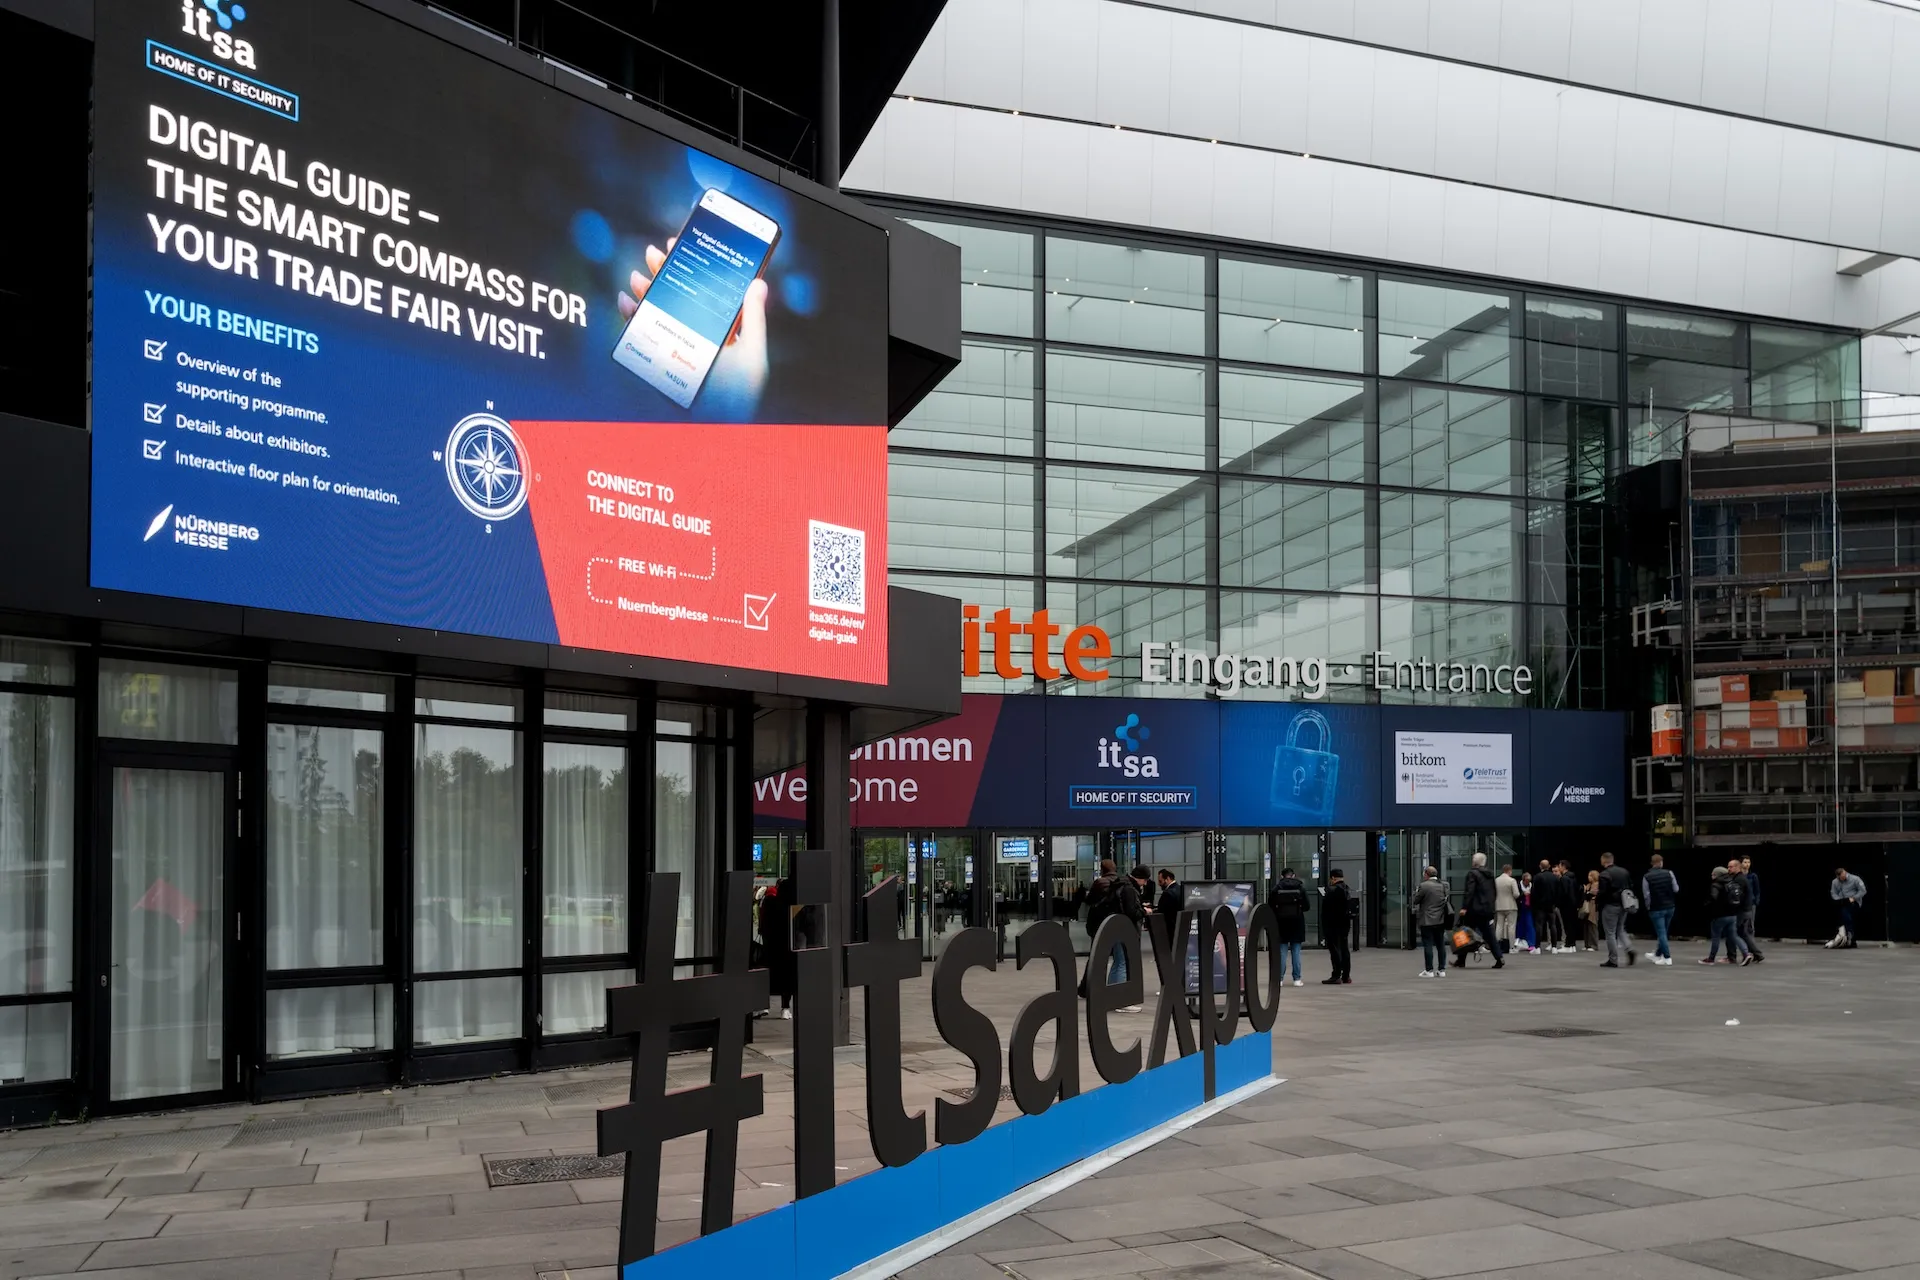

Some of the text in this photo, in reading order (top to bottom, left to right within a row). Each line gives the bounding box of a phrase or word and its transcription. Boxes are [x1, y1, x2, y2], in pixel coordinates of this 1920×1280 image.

[154, 50, 292, 112] HOME OF IT SECURITY
[149, 104, 299, 189] DIGITAL
[306, 161, 411, 226] GUIDE
[146, 158, 587, 328] THE SMART COMPASS FOR
[146, 212, 546, 360] YOUR TRADE FAIR VISIT.
[144, 290, 320, 354] YOUR BENEFITS
[176, 351, 282, 389] Overview of the
[666, 370, 689, 390] NASUNI
[176, 380, 329, 425] supporting programme.
[486, 400, 494, 410] N
[175, 413, 331, 459] Details about exhibitors.
[432, 450, 442, 461] W
[175, 450, 401, 506] Interactive floor plan for orientation.
[587, 469, 674, 503] CONNECT TO
[175, 514, 260, 541] NÜRNBERG
[587, 494, 712, 536] THE DIGITAL GUIDE
[175, 530, 229, 551] MESSE
[485, 524, 492, 534] S
[618, 557, 677, 580] FREE Wi-Fi
[618, 596, 709, 622] NuernbergMesse
[809, 609, 865, 630] itsa365.de/en/
[809, 626, 858, 645] digital-guide
[963, 605, 1532, 700] itte Eingang Entrance
[1401, 752, 1446, 766] bitkom
[1076, 792, 1191, 803] HOME OF IT SECURITY
[1564, 785, 1606, 796] NÜRNBERG
[1564, 795, 1590, 803] MESSE
[597, 850, 1280, 1280] #itsaexpo
